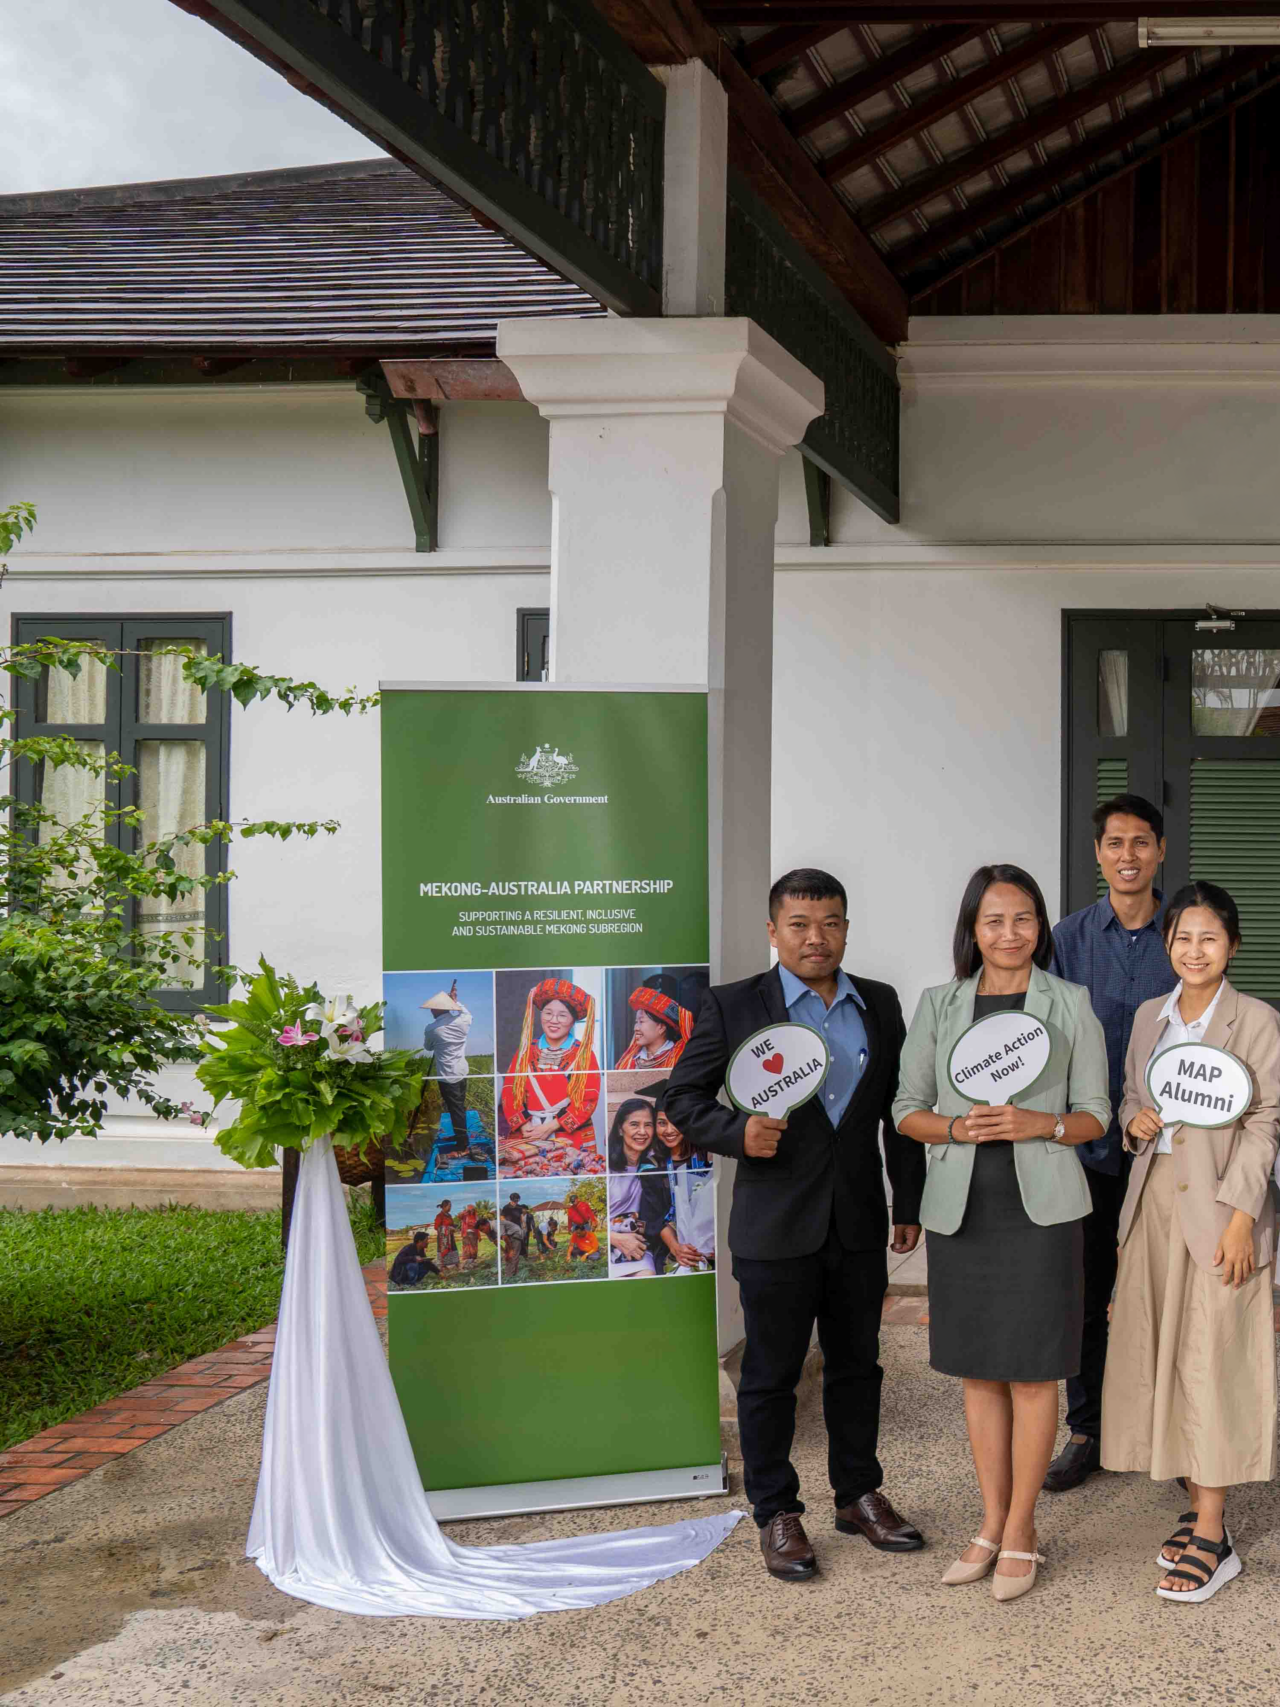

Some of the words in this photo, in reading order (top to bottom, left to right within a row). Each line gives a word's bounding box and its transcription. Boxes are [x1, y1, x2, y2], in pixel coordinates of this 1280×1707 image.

[486, 794, 541, 804] Australian
[544, 794, 608, 804] Government
[420, 881, 571, 896] MEKONG-AUSTRALIA
[575, 880, 673, 895] PARTNERSHIP
[459, 911, 521, 921] SUPPORTING
[524, 911, 531, 920] A
[534, 910, 584, 920] RESILIENT,
[587, 909, 636, 919] INCLUSIVE
[452, 926, 473, 936] AND
[476, 925, 543, 935] SUSTAINABLE
[546, 924, 586, 934] MEKONG
[589, 923, 642, 933] SUBREGION
[751, 1039, 775, 1058] WE
[955, 1052, 1002, 1083] Climate
[1004, 1027, 1043, 1055] Action
[990, 1056, 1024, 1082] Now!
[1178, 1059, 1222, 1083] MAP
[751, 1058, 823, 1109] AUSTRALIA
[1159, 1081, 1234, 1112] Alumni
